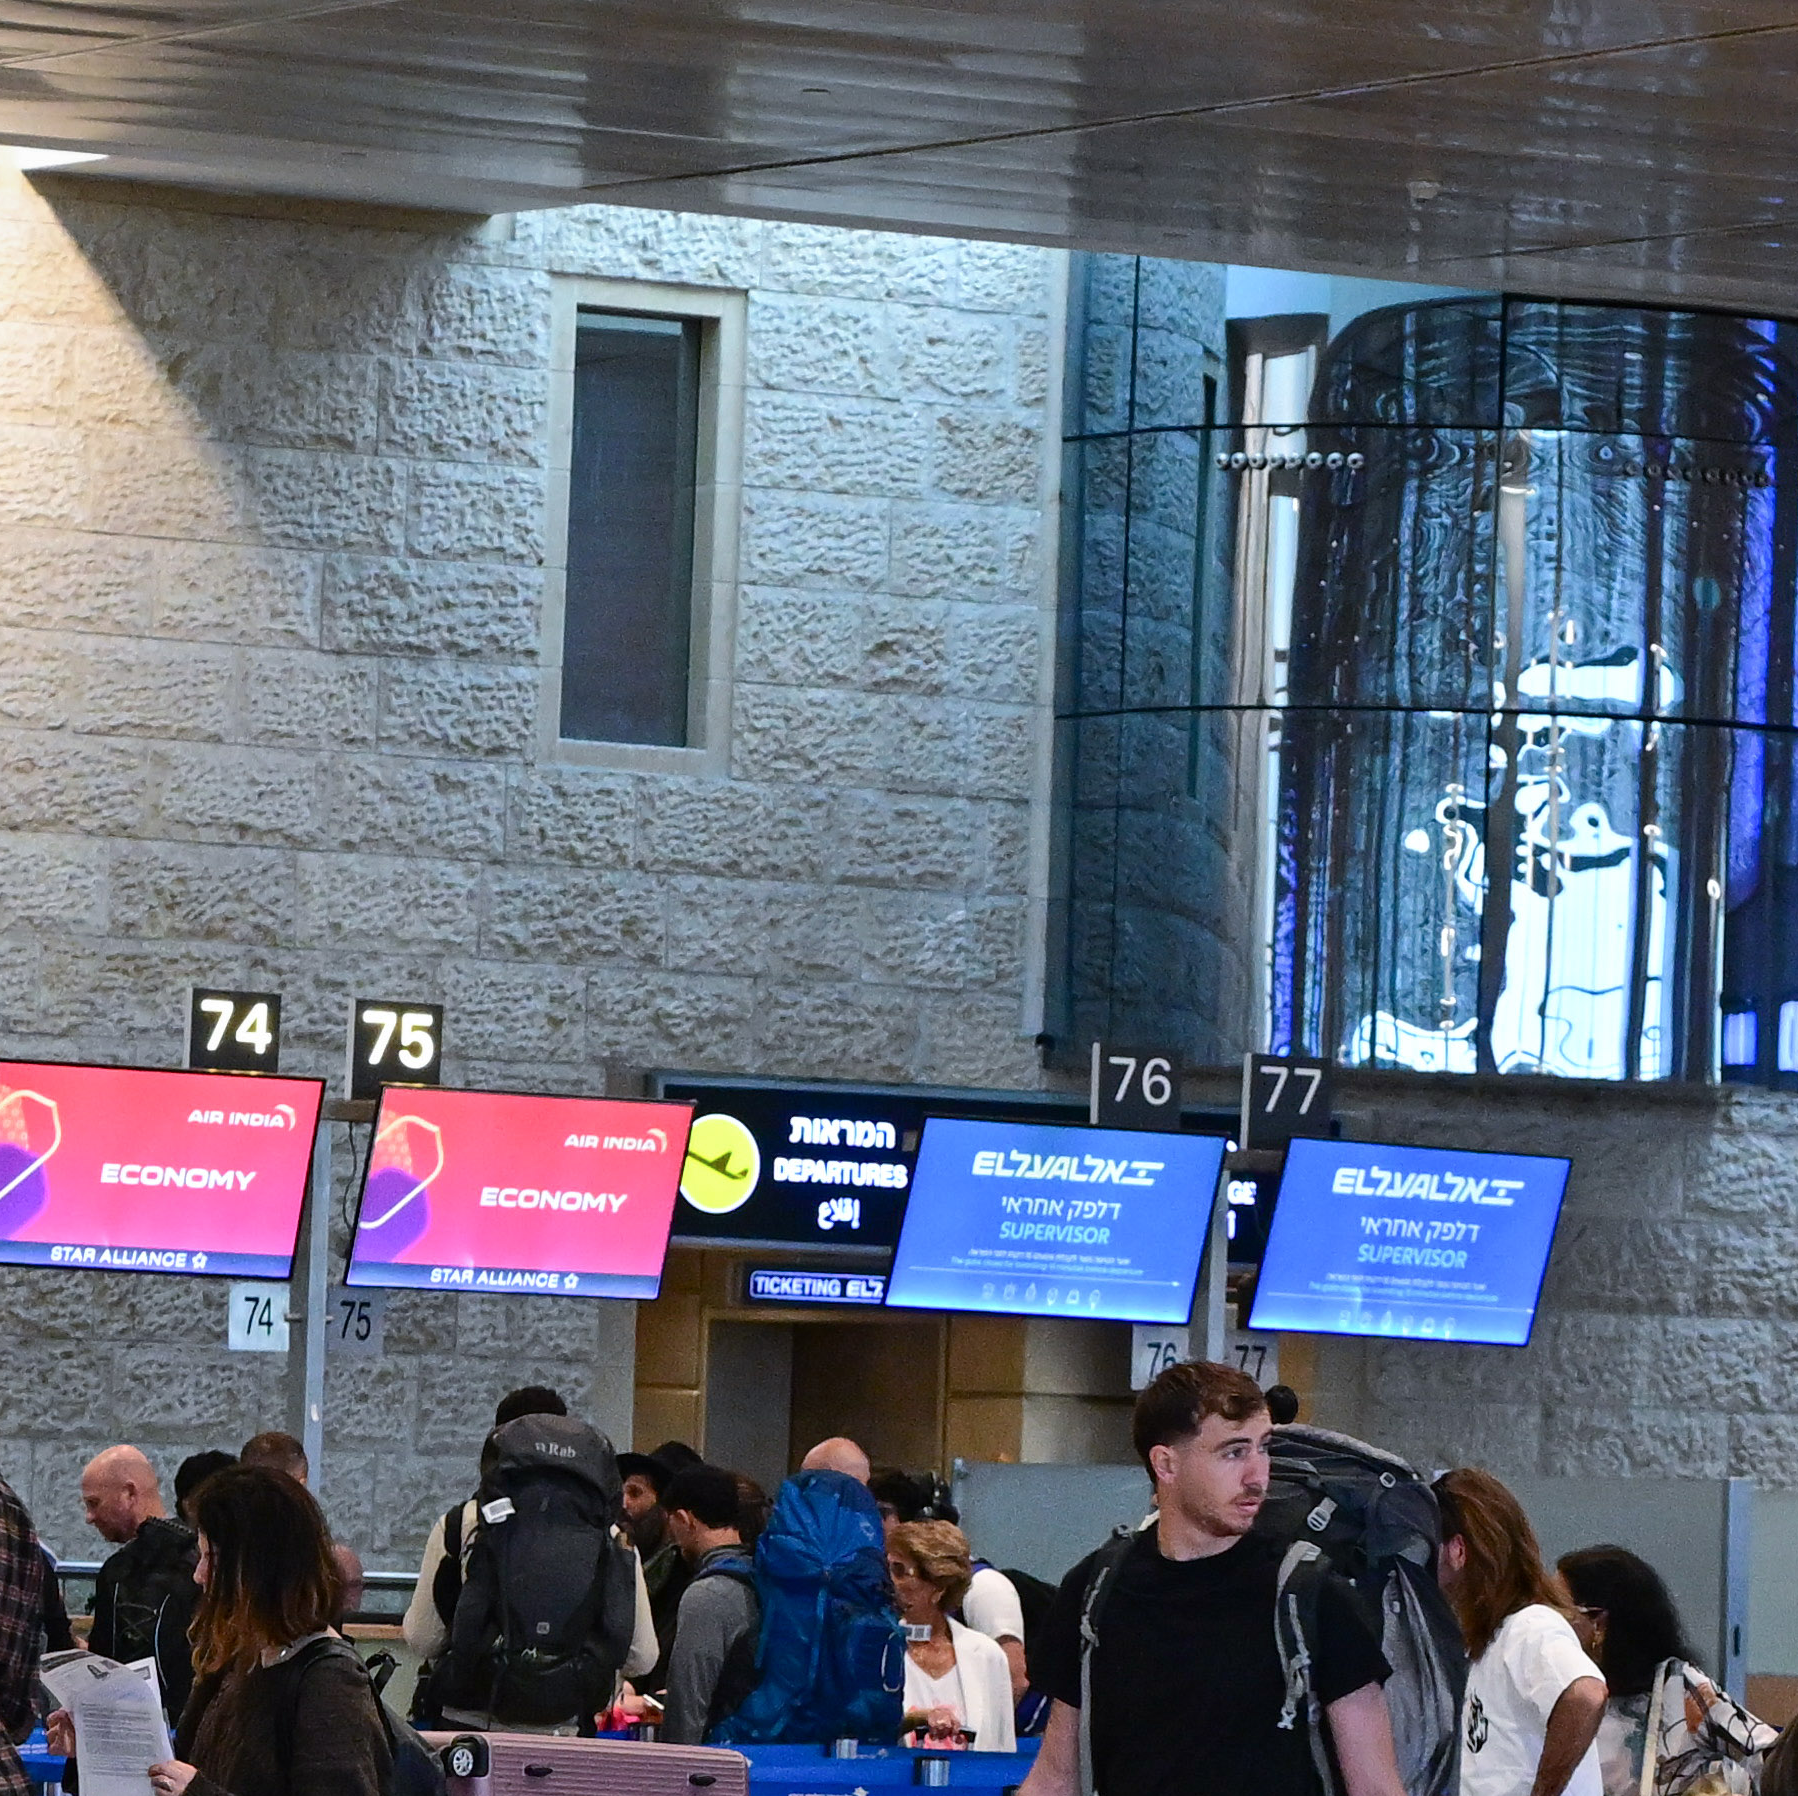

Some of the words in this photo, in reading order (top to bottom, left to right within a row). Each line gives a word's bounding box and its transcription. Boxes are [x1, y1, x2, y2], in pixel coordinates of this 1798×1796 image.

[200, 999, 273, 1055] 74
[362, 1010, 434, 1070] 75
[1108, 1055, 1172, 1106] 76
[1260, 1065, 1322, 1115] 77
[187, 1109, 225, 1124] AIR
[228, 1111, 285, 1129] INDIA
[564, 1134, 600, 1149] AIR
[603, 1136, 656, 1152] INDIA
[789, 1116, 896, 1149] המראות
[100, 1162, 258, 1191] ECONOMY
[773, 1156, 909, 1189] DEPARTURES
[479, 1187, 628, 1213] ECONOMY
[1001, 1196, 1064, 1217] אחראי
[1068, 1200, 1123, 1221] דלפק
[999, 1221, 1111, 1244] SUPERVISOR
[1360, 1216, 1424, 1239] אחראי
[1425, 1222, 1482, 1243] דלפק
[50, 1246, 96, 1263] STAR
[99, 1249, 188, 1269] ALLIANCE
[1357, 1243, 1468, 1269] SUPERVISOR
[429, 1268, 474, 1285] STAR
[476, 1271, 560, 1290] ALLIANCE
[755, 1275, 841, 1297] TICKETING
[244, 1297, 275, 1336] 74
[340, 1300, 371, 1342] 75
[1234, 1344, 1267, 1382] 77
